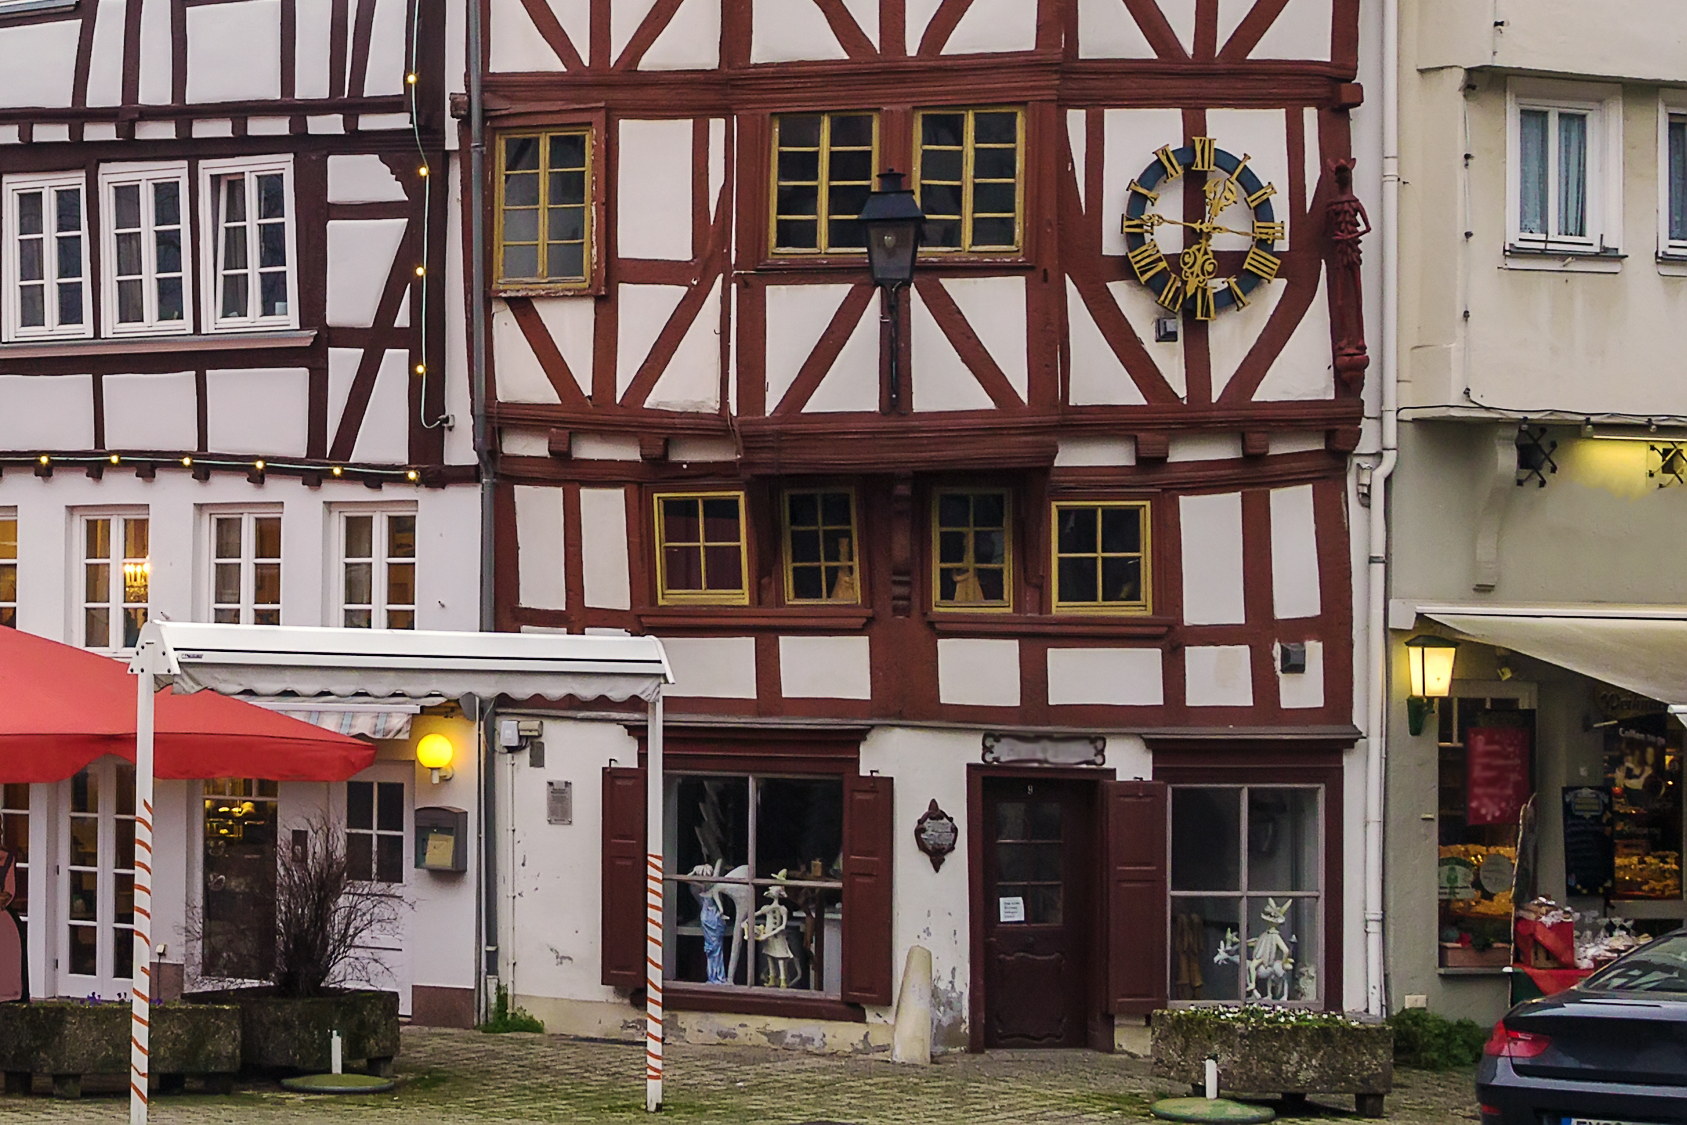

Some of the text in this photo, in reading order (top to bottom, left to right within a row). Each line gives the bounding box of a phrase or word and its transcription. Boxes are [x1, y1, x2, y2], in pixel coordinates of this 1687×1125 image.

[1153, 144, 1184, 183] XI
[1191, 136, 1216, 172] XII
[1230, 153, 1252, 183] I
[1126, 179, 1160, 206] X
[1244, 181, 1277, 210] II
[1121, 214, 1154, 236] IX
[1252, 220, 1285, 241] III
[1126, 238, 1170, 285] VIII
[1243, 246, 1281, 283] IIII
[1156, 273, 1185, 314] VII
[1195, 285, 1217, 321] VI
[1223, 275, 1250, 312] V
[1027, 784, 1033, 795] 9
